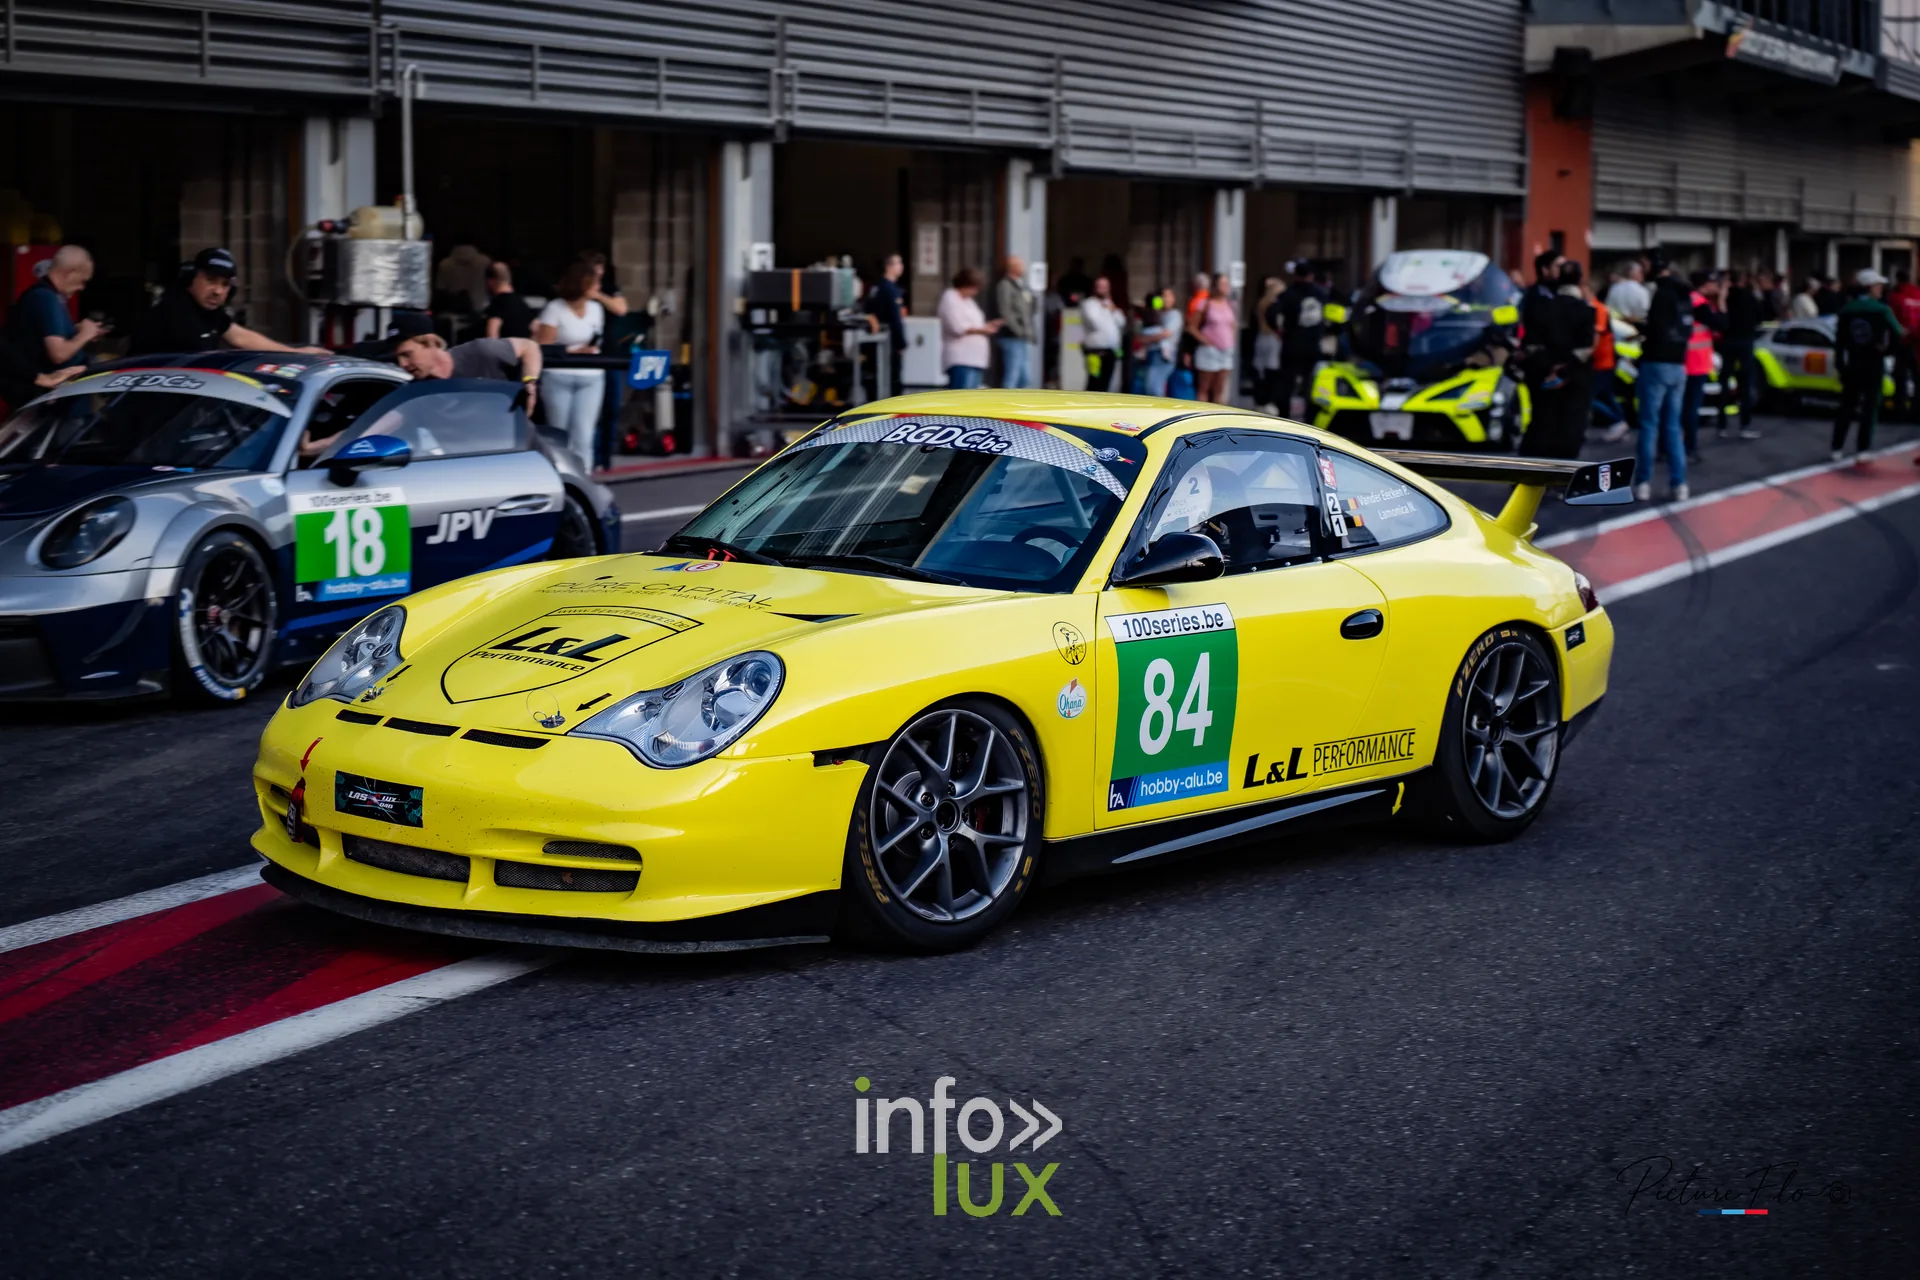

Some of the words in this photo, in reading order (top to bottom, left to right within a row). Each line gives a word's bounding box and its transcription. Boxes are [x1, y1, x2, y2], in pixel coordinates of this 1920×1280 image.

[633, 355, 668, 381] JPV
[883, 423, 1010, 454] BGDC.be
[1188, 476, 1200, 495] 2
[1328, 495, 1339, 513] 2
[425, 509, 496, 545] JPV
[1335, 517, 1344, 534] 1
[323, 507, 387, 578] 18
[547, 582, 641, 590] PURE
[642, 583, 773, 608] CAPITAL
[670, 592, 766, 611] MANAGEMENT
[1122, 609, 1225, 638] 100series.be
[486, 626, 632, 663] L&L
[1462, 632, 1495, 682] ZERO
[469, 650, 586, 673] Performance
[1059, 693, 1083, 711] Ohana
[1138, 652, 1214, 756] 84
[1242, 747, 1309, 789] L&L
[1313, 731, 1416, 773] PERFORMANCE
[1019, 748, 1041, 821] ZERO
[1140, 769, 1223, 797] hobby-alu.be
